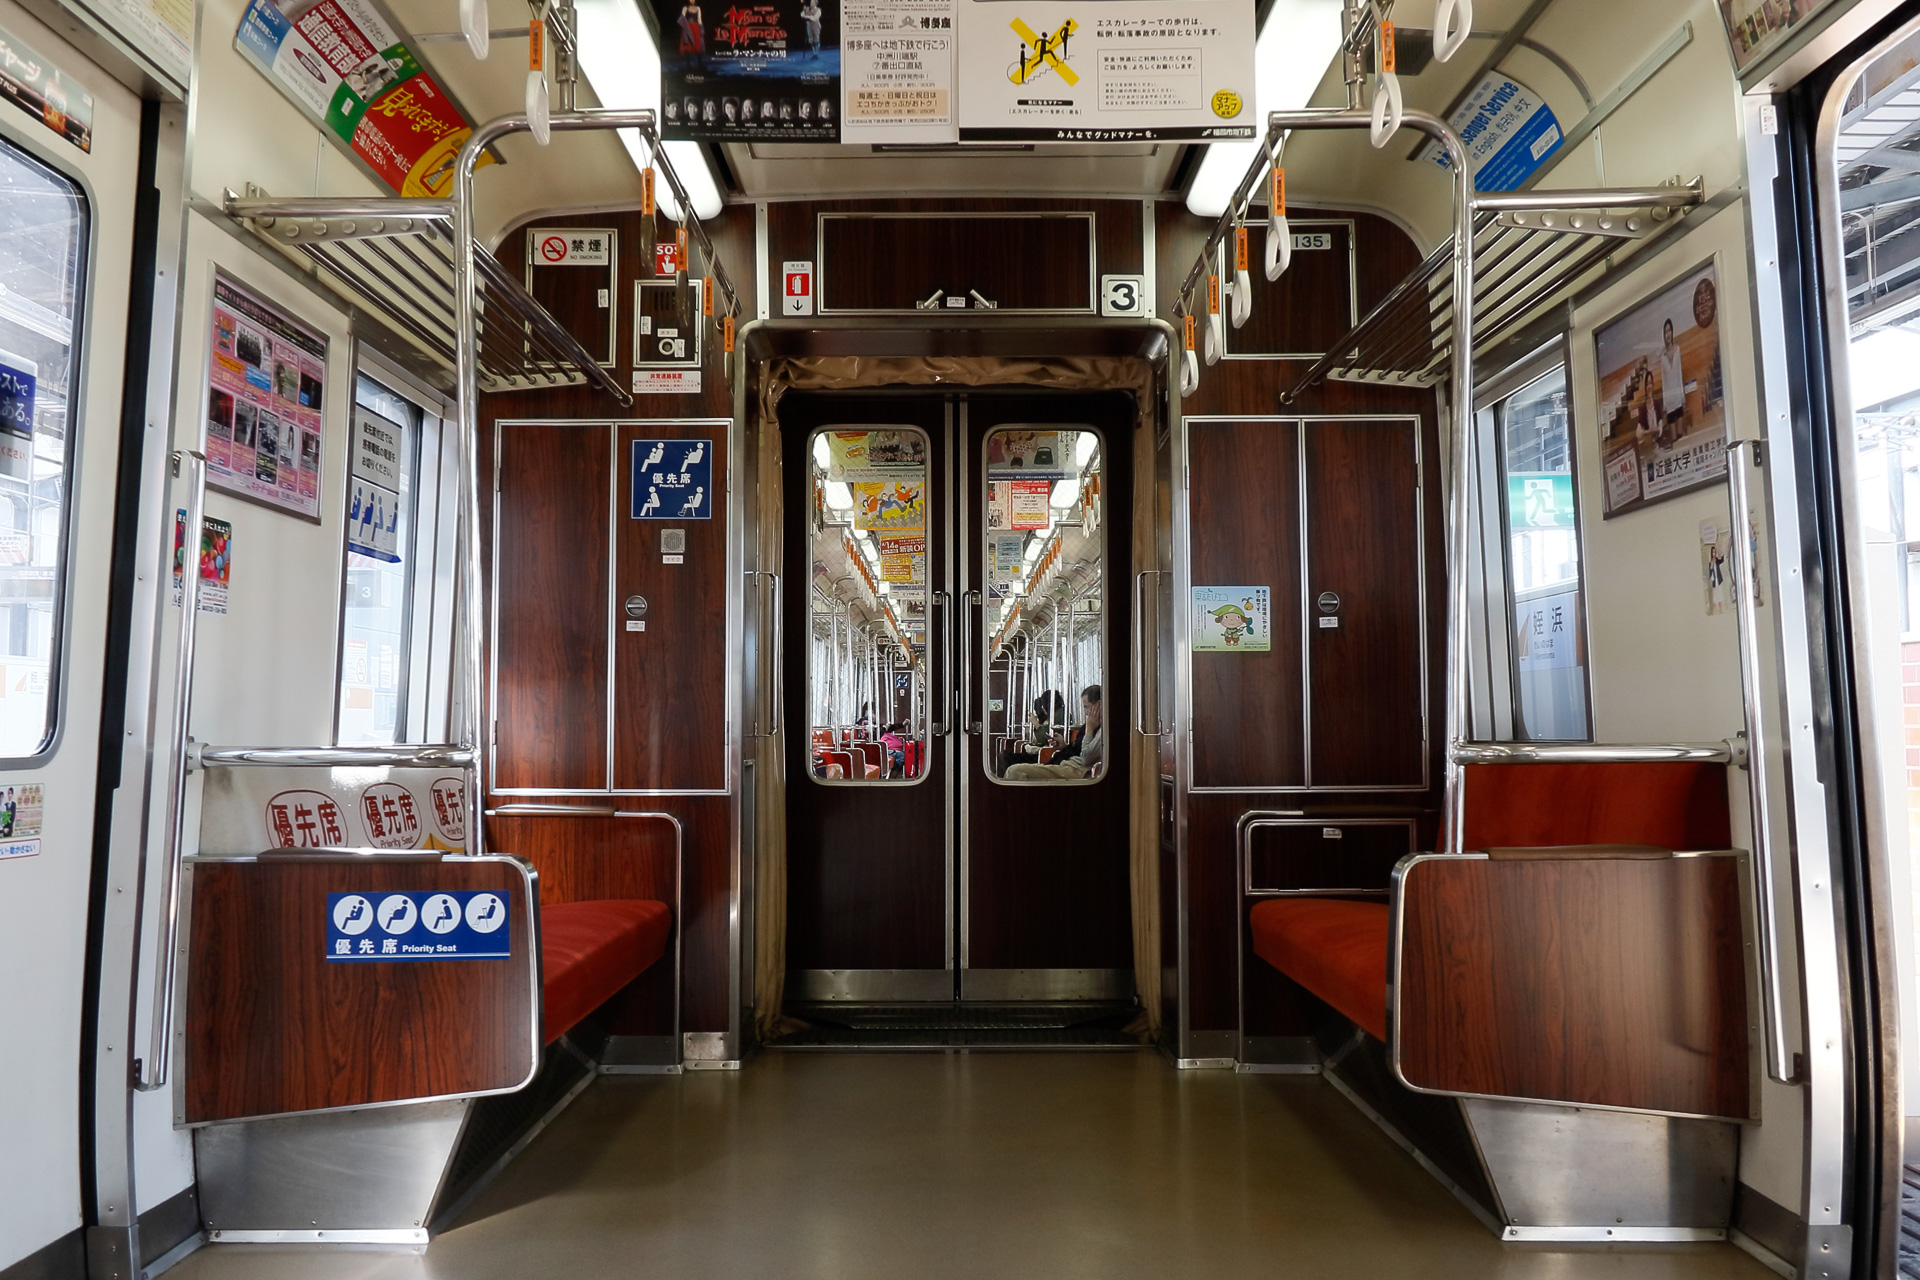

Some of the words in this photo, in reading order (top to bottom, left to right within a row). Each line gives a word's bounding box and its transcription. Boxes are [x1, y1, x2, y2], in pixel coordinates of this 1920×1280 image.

[297, 9, 362, 75] 通信教育部
[733, 49, 787, 58] ラ・マンチャの男
[876, 52, 919, 61] 中洲川端駅
[1216, 96, 1238, 104] マナー
[1484, 81, 1520, 116] Service
[1514, 97, 1532, 114] 中文
[1057, 130, 1158, 139] みんなでグッドマナーを。
[571, 239, 602, 252] 禁煙
[1294, 235, 1324, 249] 135
[1110, 283, 1136, 311] 3
[1654, 451, 1692, 479] 近畿大学
[652, 472, 692, 484] 優先席
[361, 586, 371, 598] 3
[1533, 606, 1563, 635] 姪浜
[363, 792, 418, 839] 優先席
[270, 800, 342, 849] 優先席
[446, 826, 463, 836] Priority
[380, 838, 401, 848] Priority
[401, 835, 414, 845] Seat
[335, 939, 398, 954] 優先席
[402, 944, 434, 954] Priority
[436, 944, 457, 952] Seat
